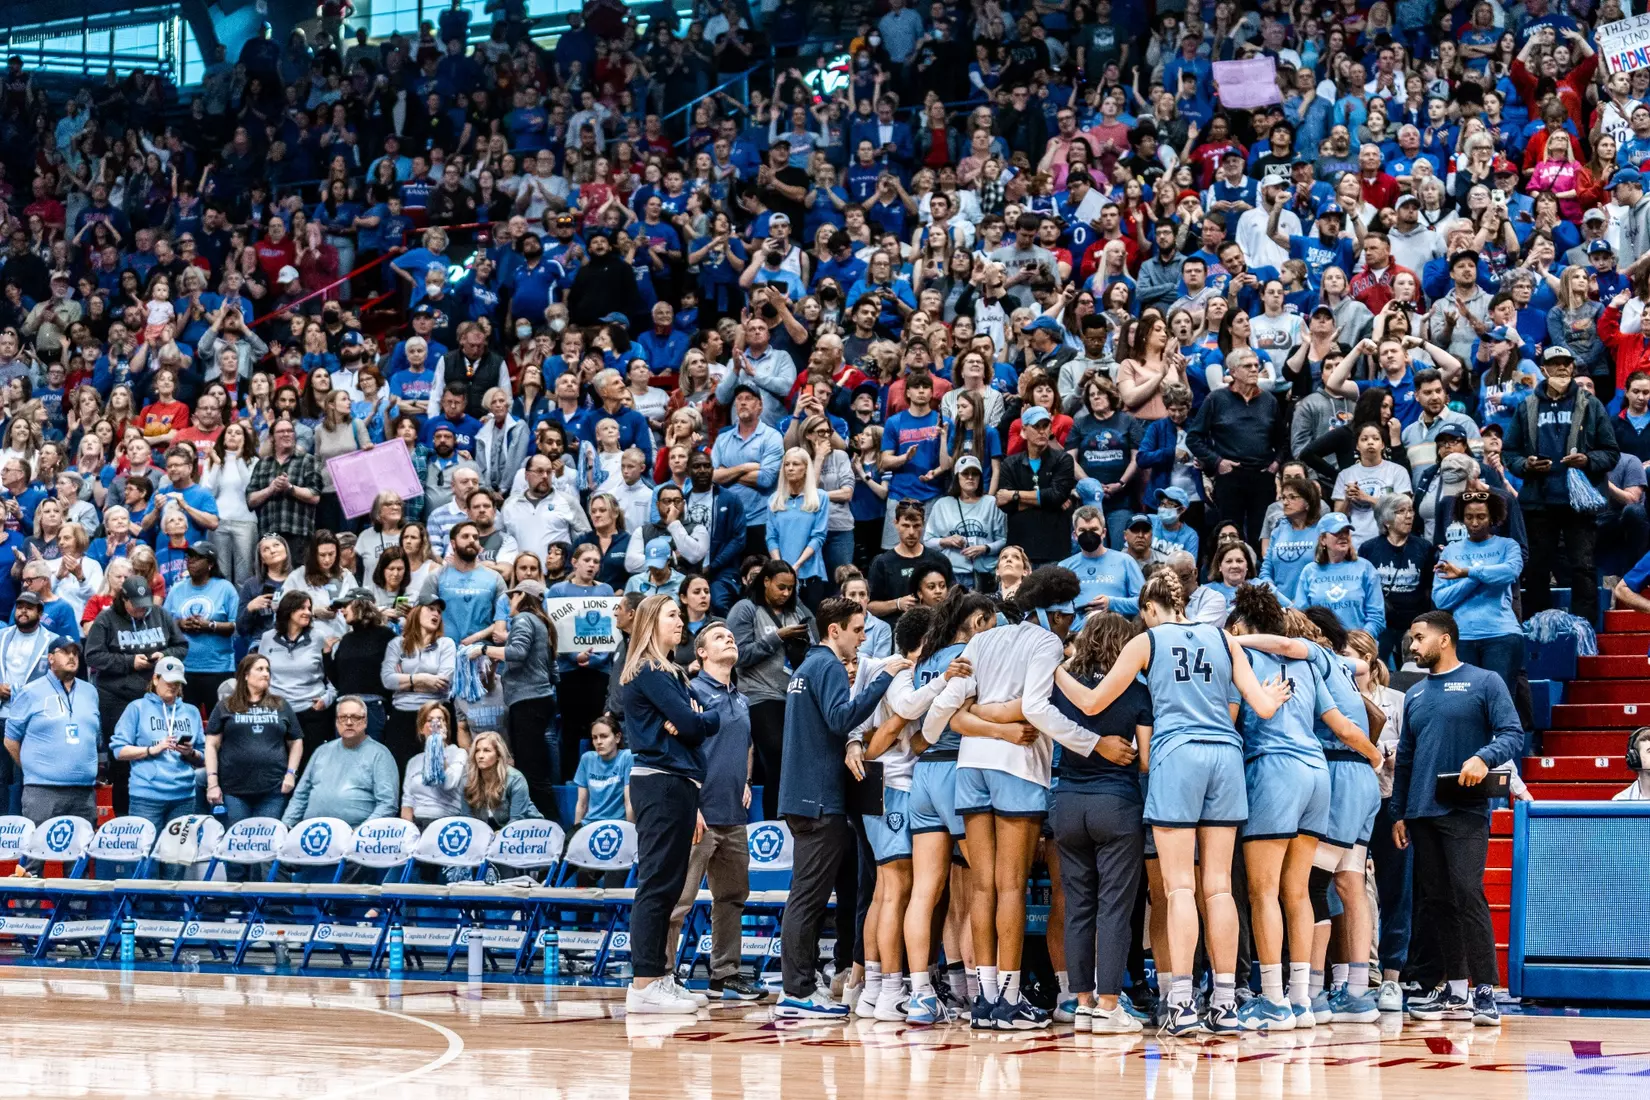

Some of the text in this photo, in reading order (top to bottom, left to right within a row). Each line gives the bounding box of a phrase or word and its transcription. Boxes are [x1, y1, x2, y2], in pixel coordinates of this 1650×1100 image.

[1604, 14, 1650, 36] THIS IS
[1622, 29, 1649, 46] KIND
[860, 182, 866, 197] 1
[1074, 229, 1086, 245] 0
[1095, 491, 1101, 502] C
[650, 548, 657, 558] C
[1455, 550, 1500, 561] COLUMBIA
[1314, 574, 1361, 584] COLUMBIA
[551, 603, 576, 622] ROAR
[583, 600, 607, 609] LIONS
[573, 635, 615, 646] COLUMBIA
[1171, 645, 1214, 684] 34
[150, 715, 191, 733] COLMBIA
[235, 714, 279, 724] UNIVERSITY
[1600, 759, 1605, 767] 3
[102, 822, 145, 838] Capitol
[168, 821, 182, 836] G
[231, 824, 276, 840] Capitol
[358, 823, 407, 841] Capitol
[502, 825, 553, 841] Capitol
[97, 836, 140, 850] Federal
[228, 838, 272, 852] Federal
[355, 840, 402, 854] Federal
[499, 840, 549, 855] Federal
[1026, 914, 1048, 922] POWE
[5, 922, 44, 930] Capitol Federal
[65, 924, 106, 934] Capitol Federal
[200, 926, 241, 935] Capitol Federal
[287, 929, 308, 937] Federal
[332, 929, 376, 940] Capitol Federal
[405, 932, 427, 942] Capitol
[576, 937, 600, 945] Federal
